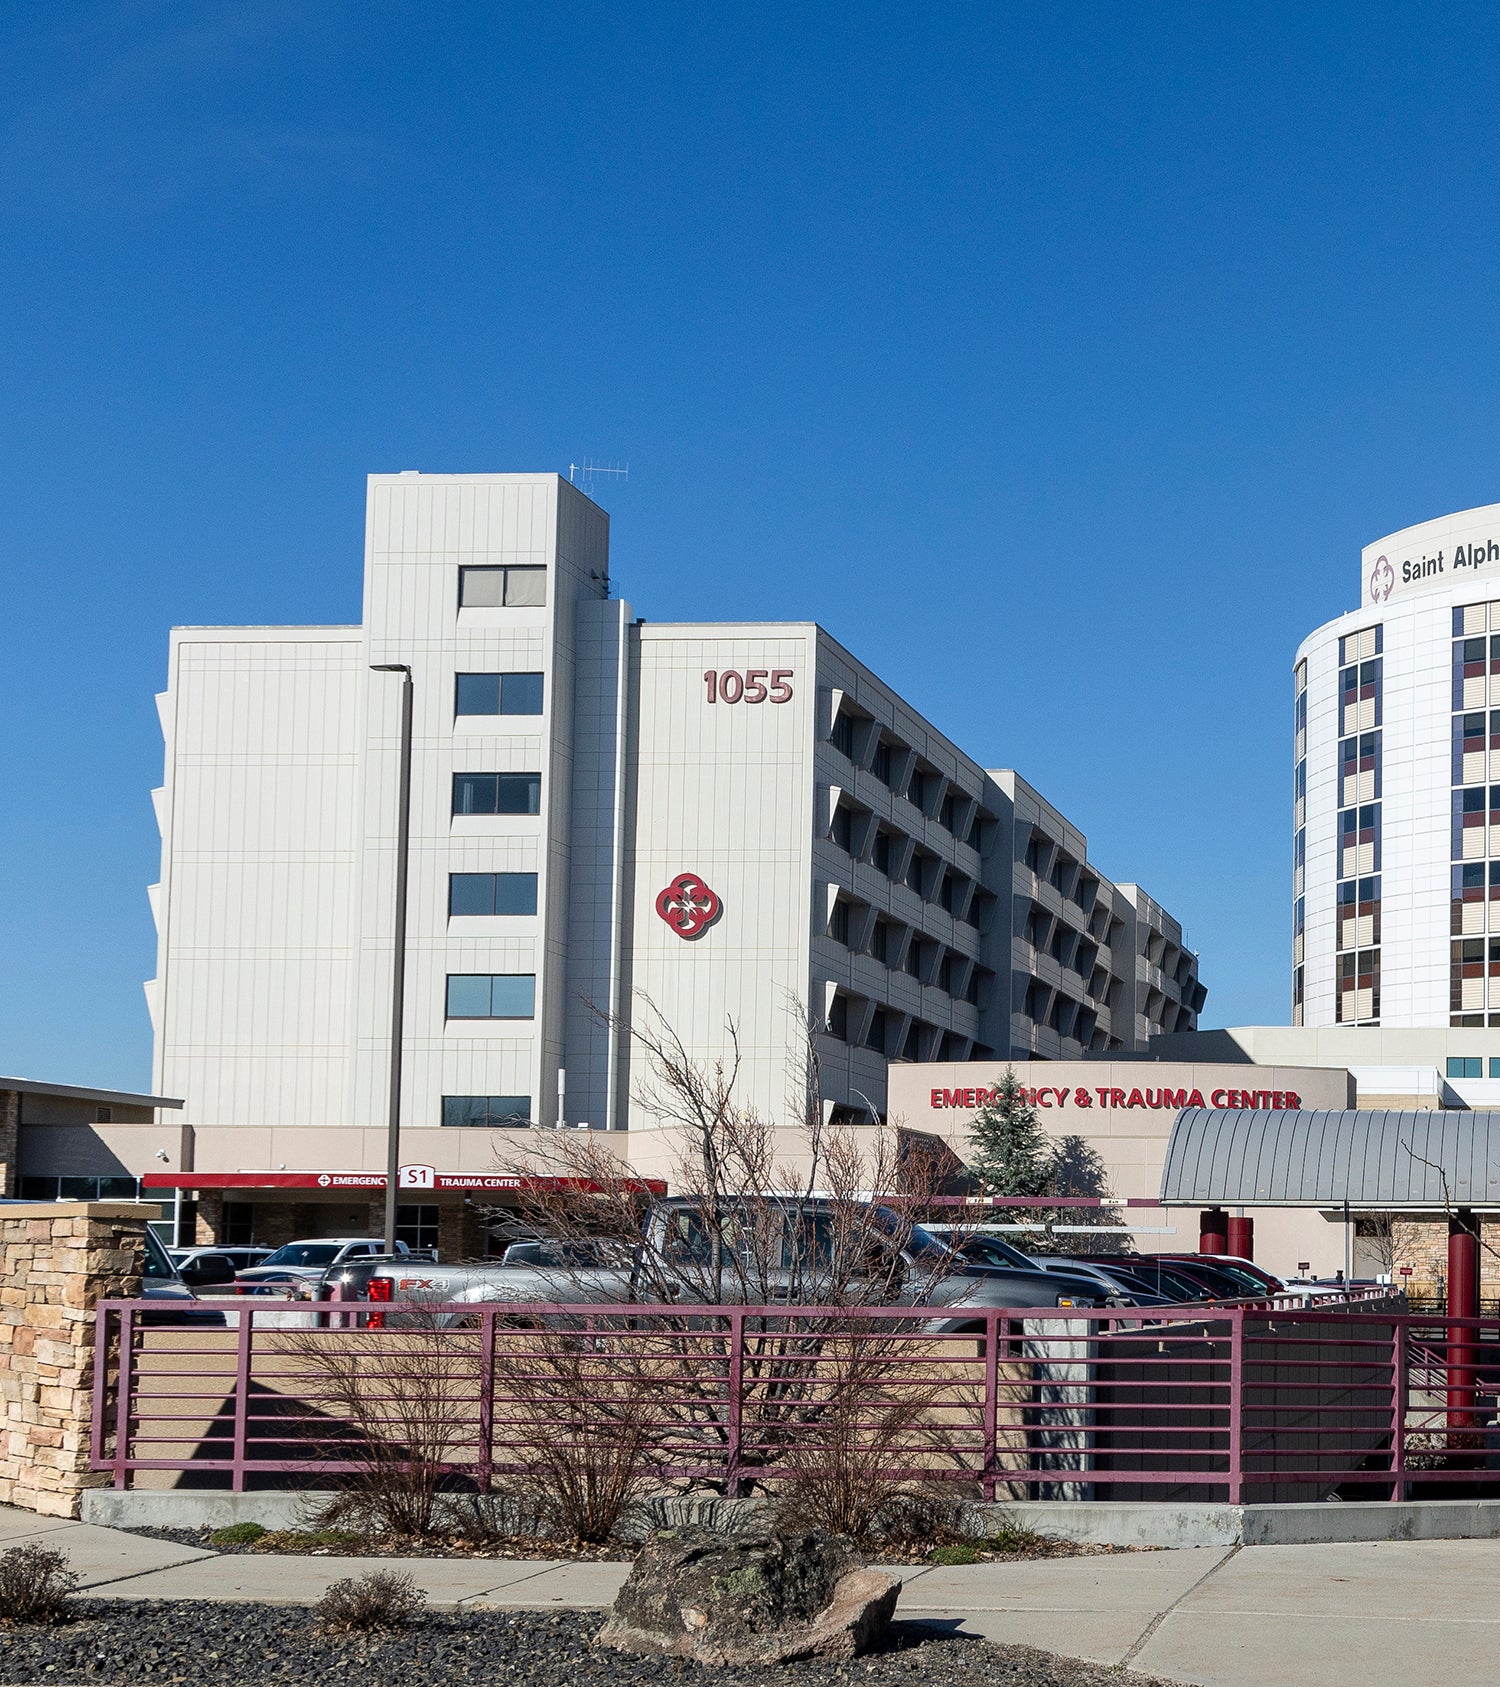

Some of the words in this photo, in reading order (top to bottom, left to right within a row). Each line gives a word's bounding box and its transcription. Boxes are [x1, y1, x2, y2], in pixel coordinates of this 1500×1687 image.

[1402, 550, 1444, 584] Saint
[704, 669, 794, 704] 1055
[930, 1087, 1070, 1109] EMERGNCY
[1074, 1087, 1093, 1108] &
[1096, 1087, 1207, 1110] TRAUMA
[1210, 1089, 1302, 1111] CENTER
[408, 1169, 428, 1184] S1
[440, 1178, 483, 1187] TRAUMA
[484, 1178, 521, 1188] CENTER
[399, 1278, 449, 1291] FX4
